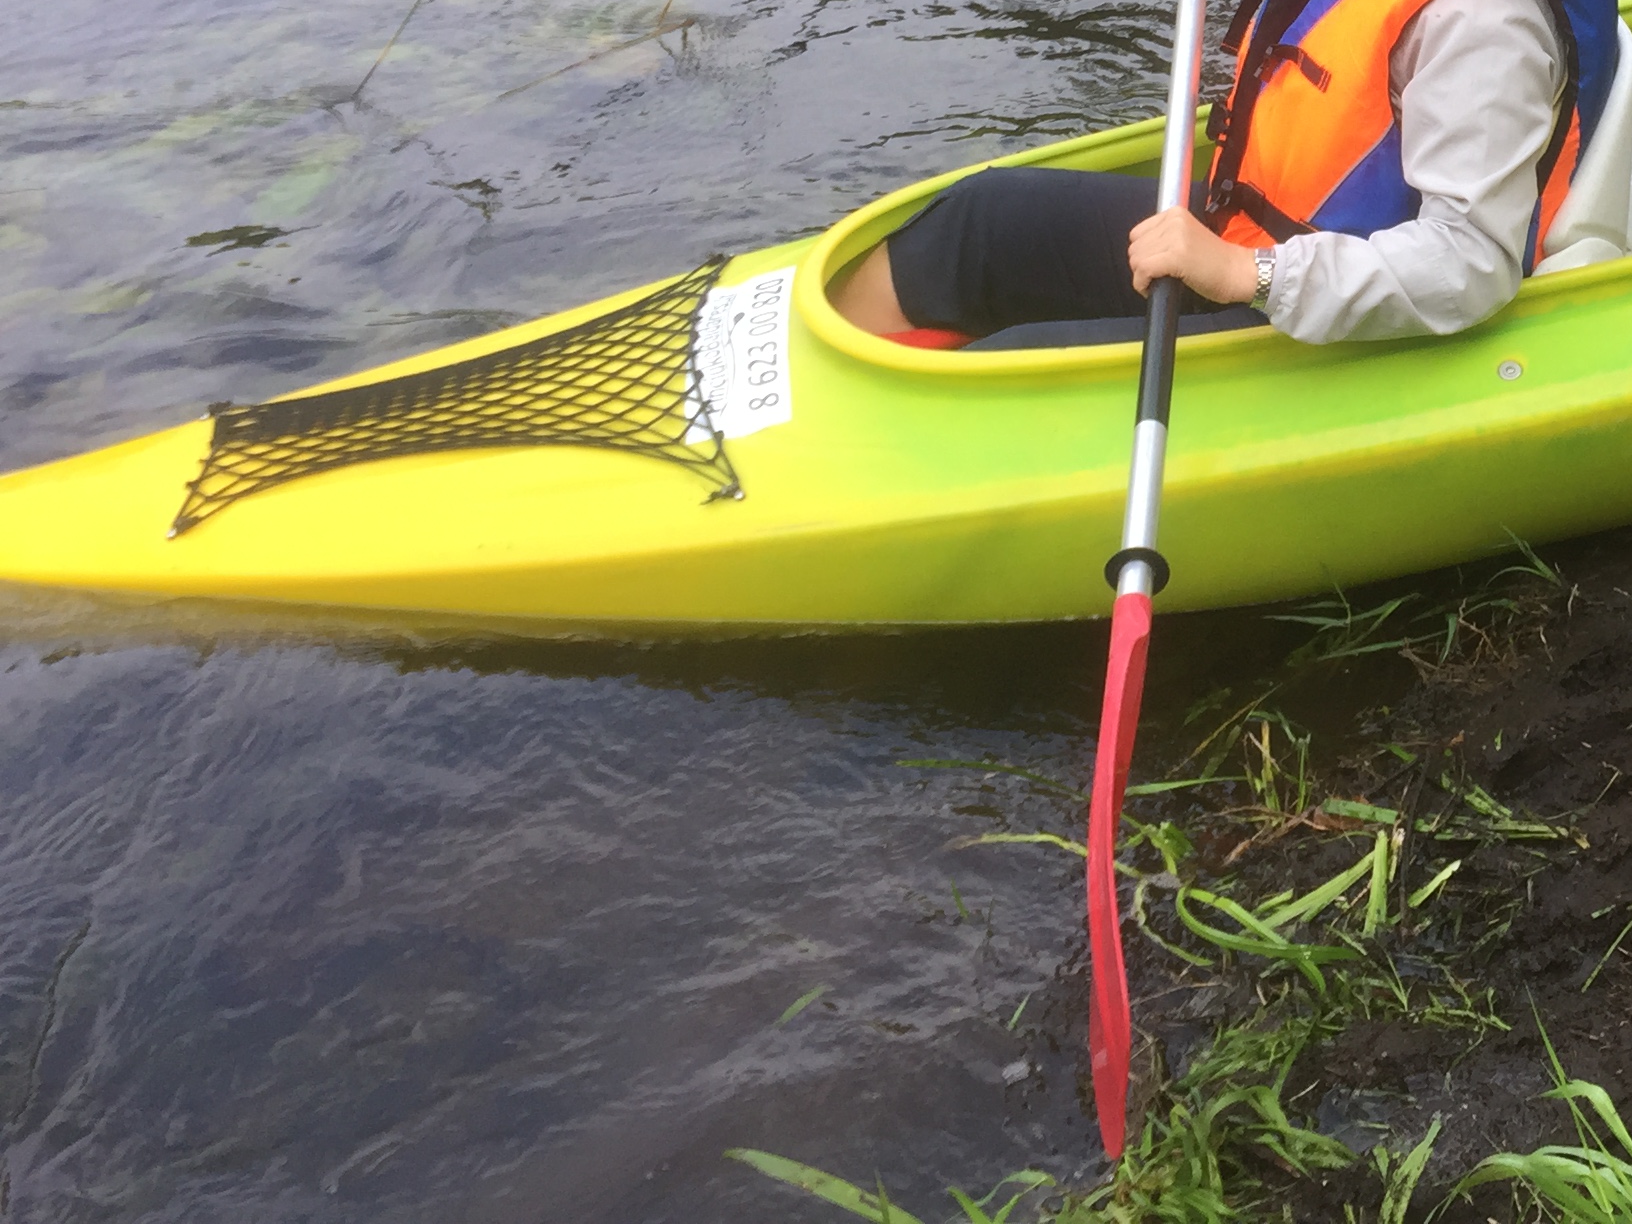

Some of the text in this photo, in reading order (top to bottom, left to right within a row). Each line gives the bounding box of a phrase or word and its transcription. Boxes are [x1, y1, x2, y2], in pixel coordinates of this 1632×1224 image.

[748, 277, 784, 411] 8 623 00 820
